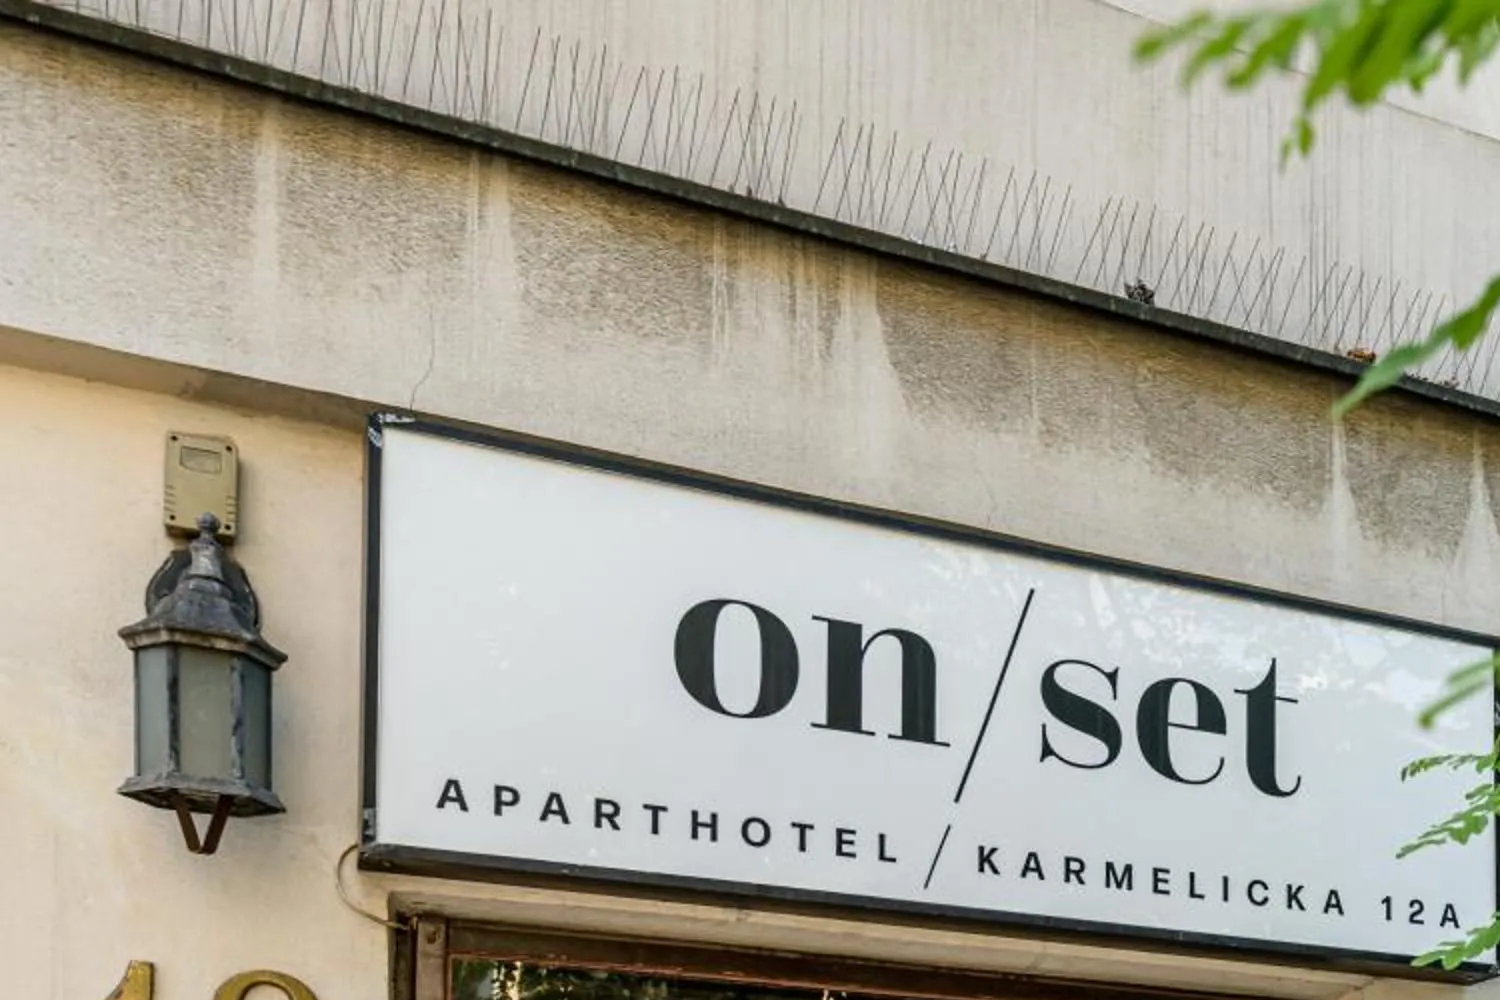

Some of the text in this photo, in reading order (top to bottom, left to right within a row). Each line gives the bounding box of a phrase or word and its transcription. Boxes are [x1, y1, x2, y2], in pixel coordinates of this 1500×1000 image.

[674, 588, 1302, 804] on/set
[435, 778, 898, 864] APARTHOTEL
[976, 844, 1346, 917] KARMELICKA
[1380, 894, 1461, 930] 12A
